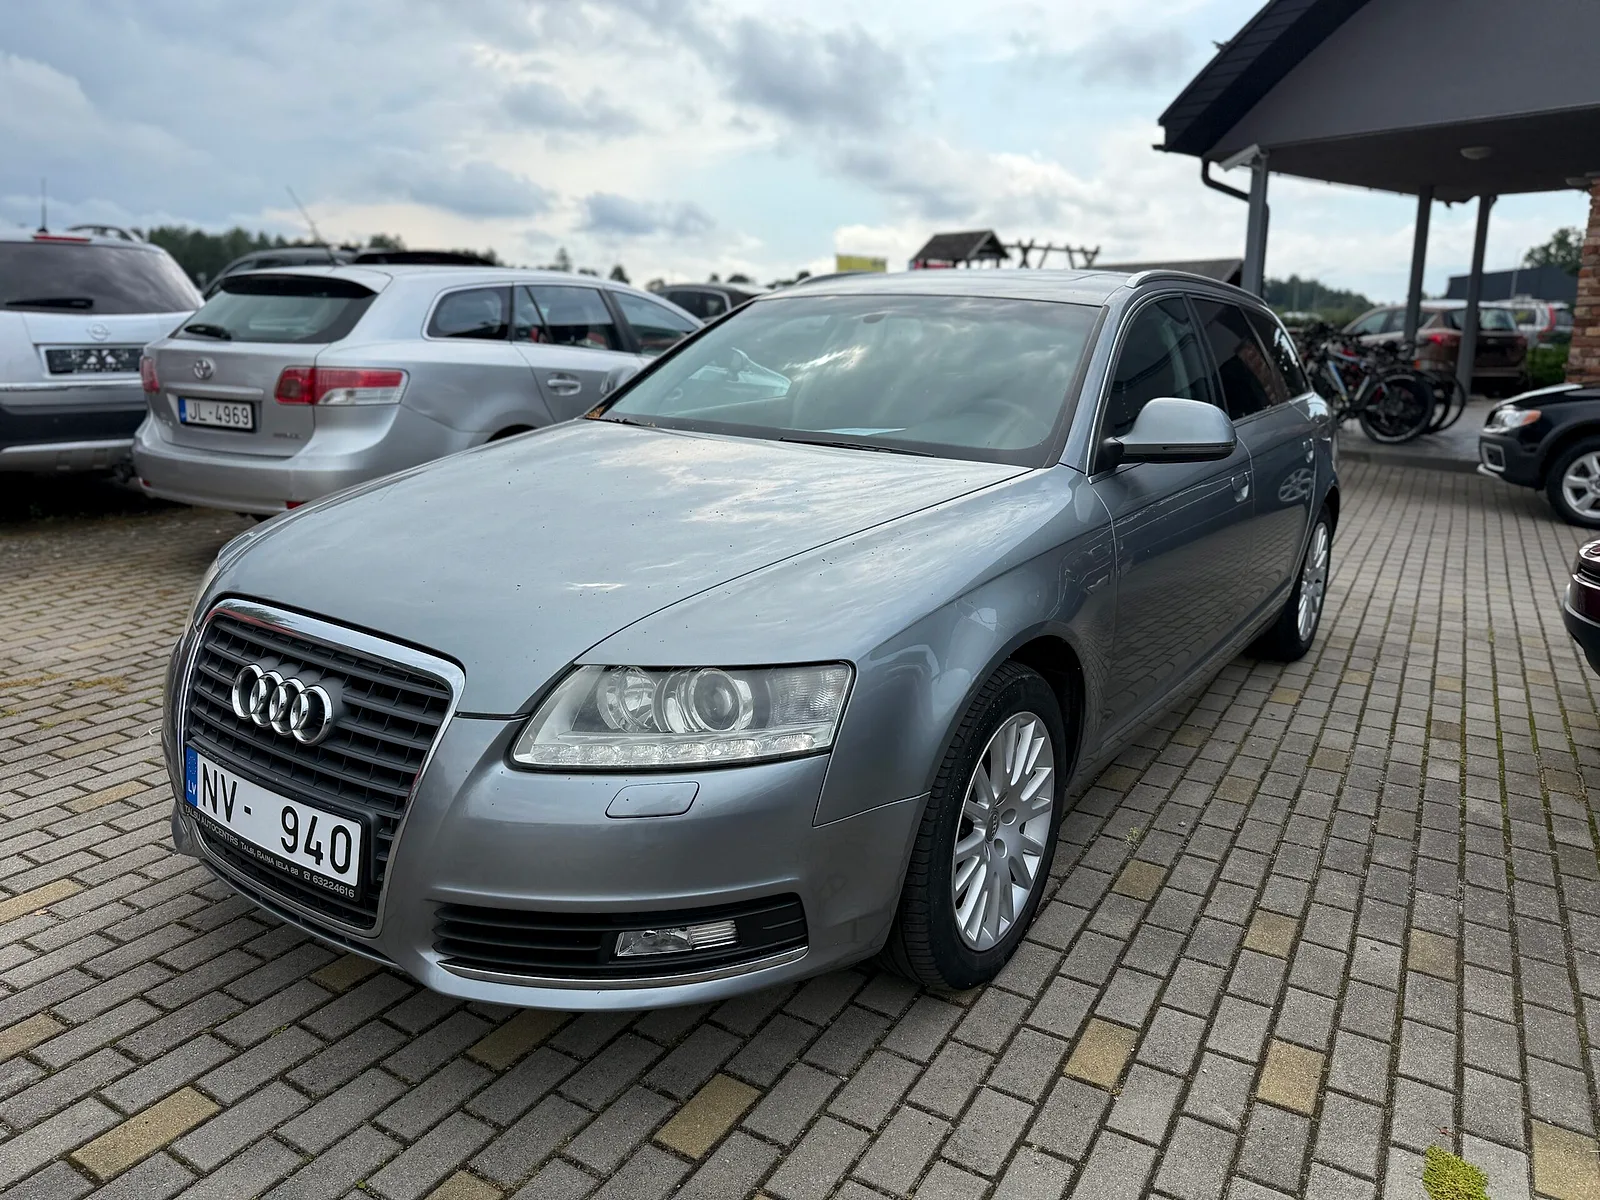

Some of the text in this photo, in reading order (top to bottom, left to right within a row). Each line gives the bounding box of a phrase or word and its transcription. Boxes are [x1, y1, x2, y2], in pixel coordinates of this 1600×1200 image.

[187, 779, 197, 796] LV
[201, 816, 239, 846] AUTOCENTRS
[312, 875, 355, 898] 63224616
[280, 805, 352, 874] 940
